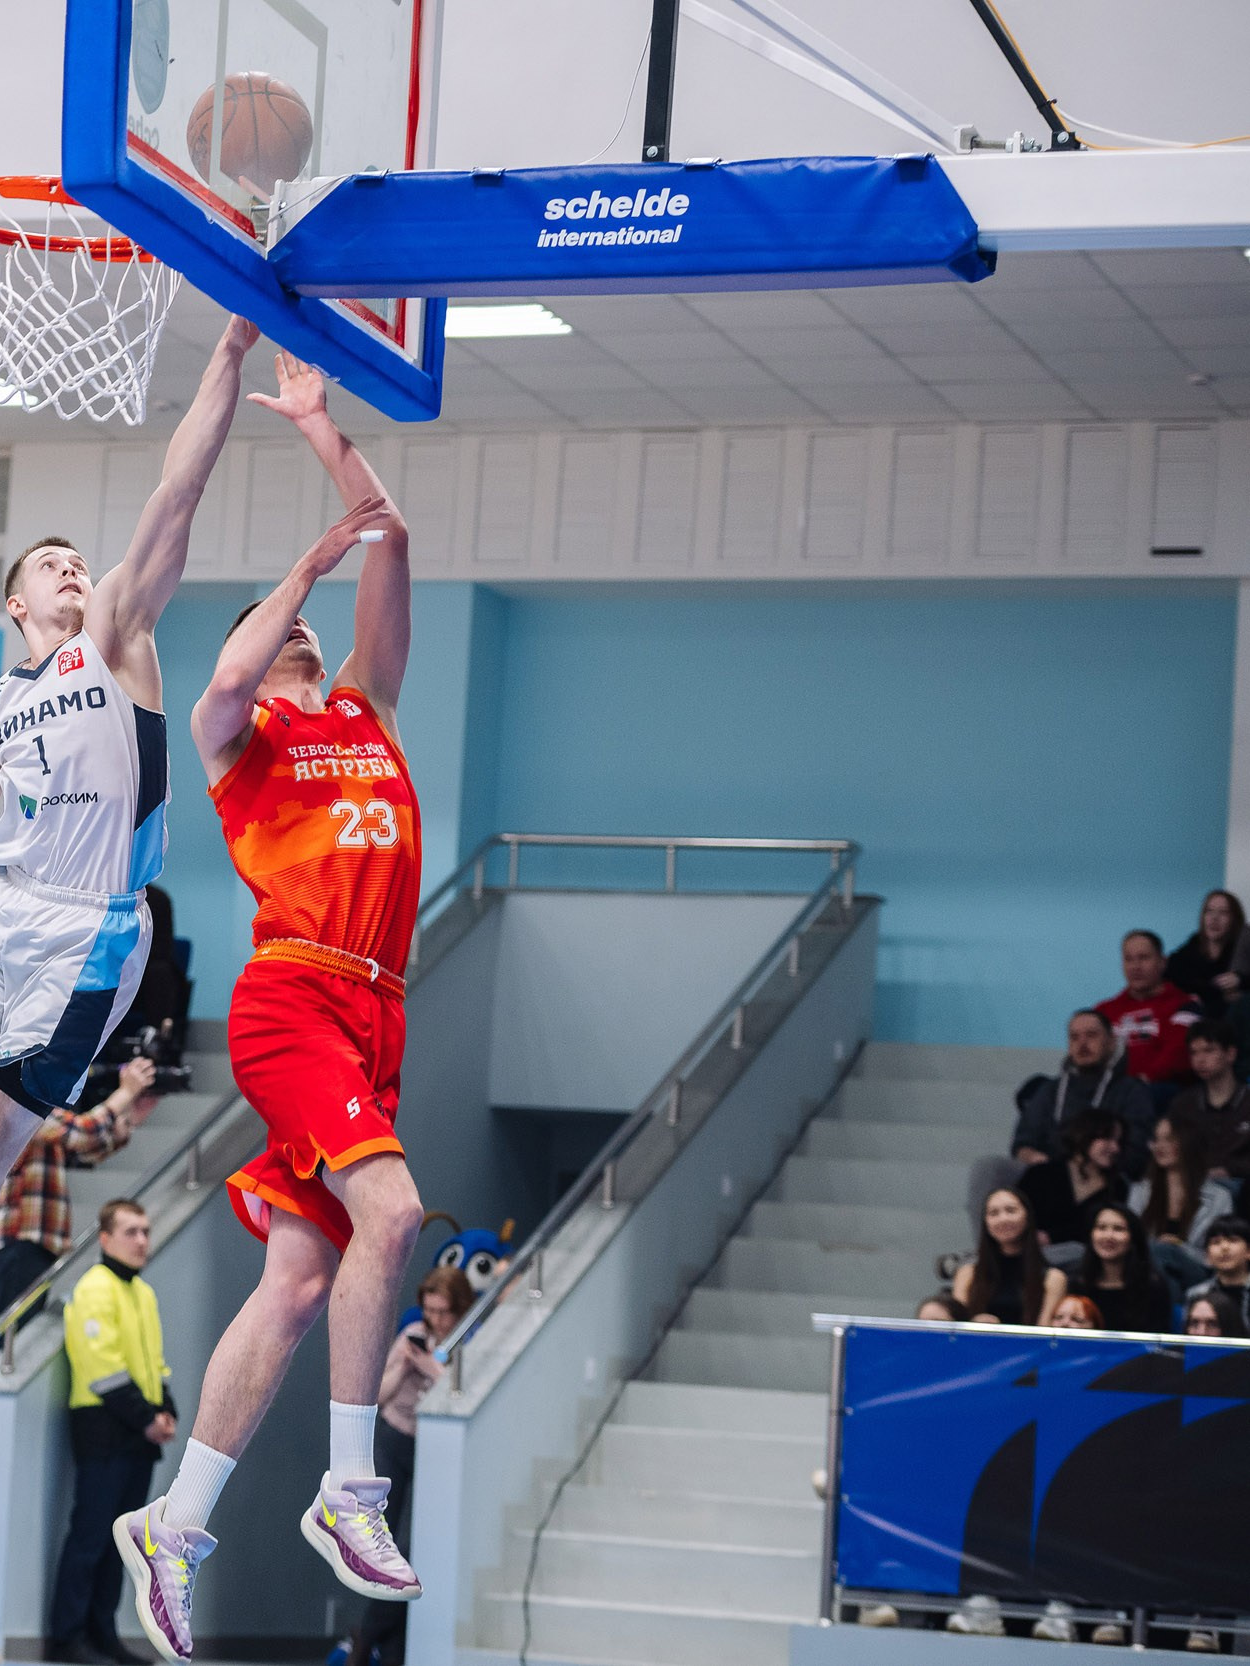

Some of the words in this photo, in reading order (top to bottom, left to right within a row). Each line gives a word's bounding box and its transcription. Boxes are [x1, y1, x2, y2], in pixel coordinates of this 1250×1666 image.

[544, 188, 690, 220] schelde
[537, 224, 683, 248] international
[32, 734, 51, 776] 1
[328, 798, 400, 849] 23
